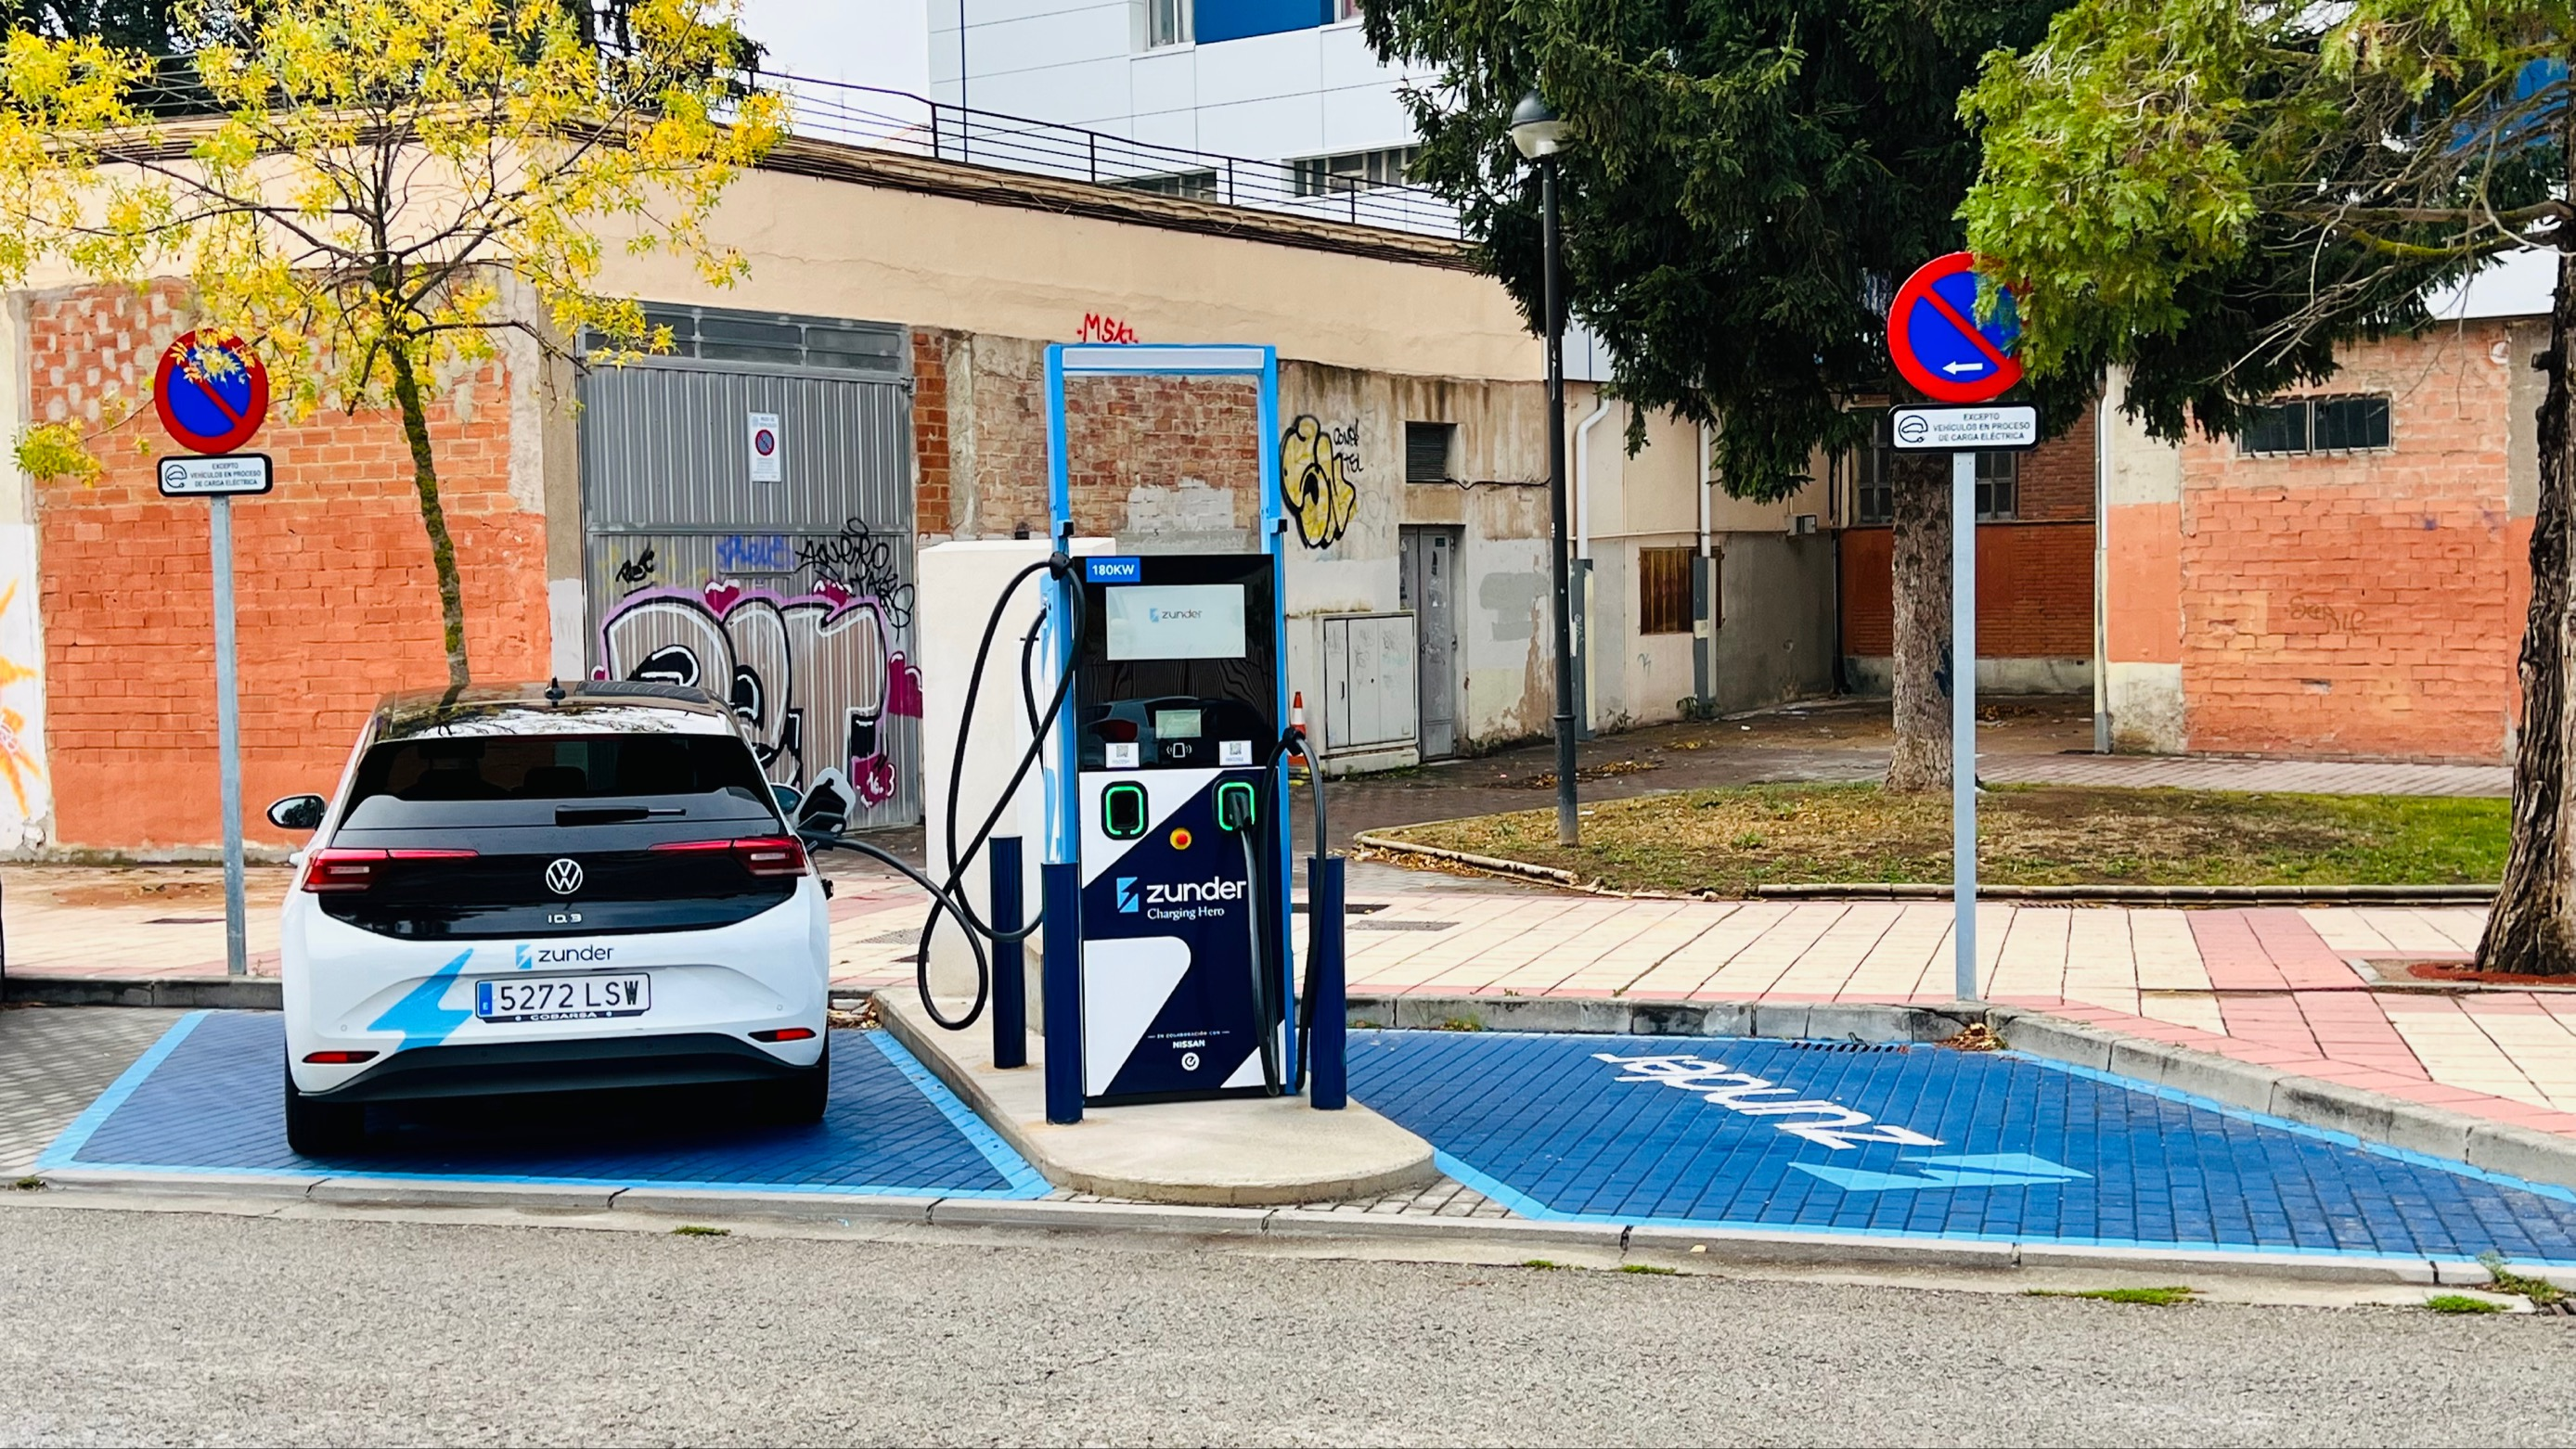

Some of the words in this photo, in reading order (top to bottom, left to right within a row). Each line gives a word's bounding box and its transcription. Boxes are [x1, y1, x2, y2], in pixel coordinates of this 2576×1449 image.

[1933, 422, 1977, 431] VEHÍCULOS
[1991, 421, 2030, 430] PROCESO
[1980, 431, 2025, 441] ELÉCTRICA
[190, 470, 223, 479] VEHÍCULOS
[225, 478, 257, 487] ELÉCTRICA
[1092, 564, 1135, 576] 180KW
[1162, 609, 1203, 620] zunder
[1146, 876, 1247, 904] zunder
[1147, 907, 1196, 921] Charging
[1198, 906, 1225, 917] Hero
[538, 944, 614, 963] zunder
[500, 983, 573, 1011] 5272
[586, 980, 639, 1007] LSW
[1172, 1039, 1205, 1049] NISSAN
[1591, 1053, 1945, 1149] zunder
